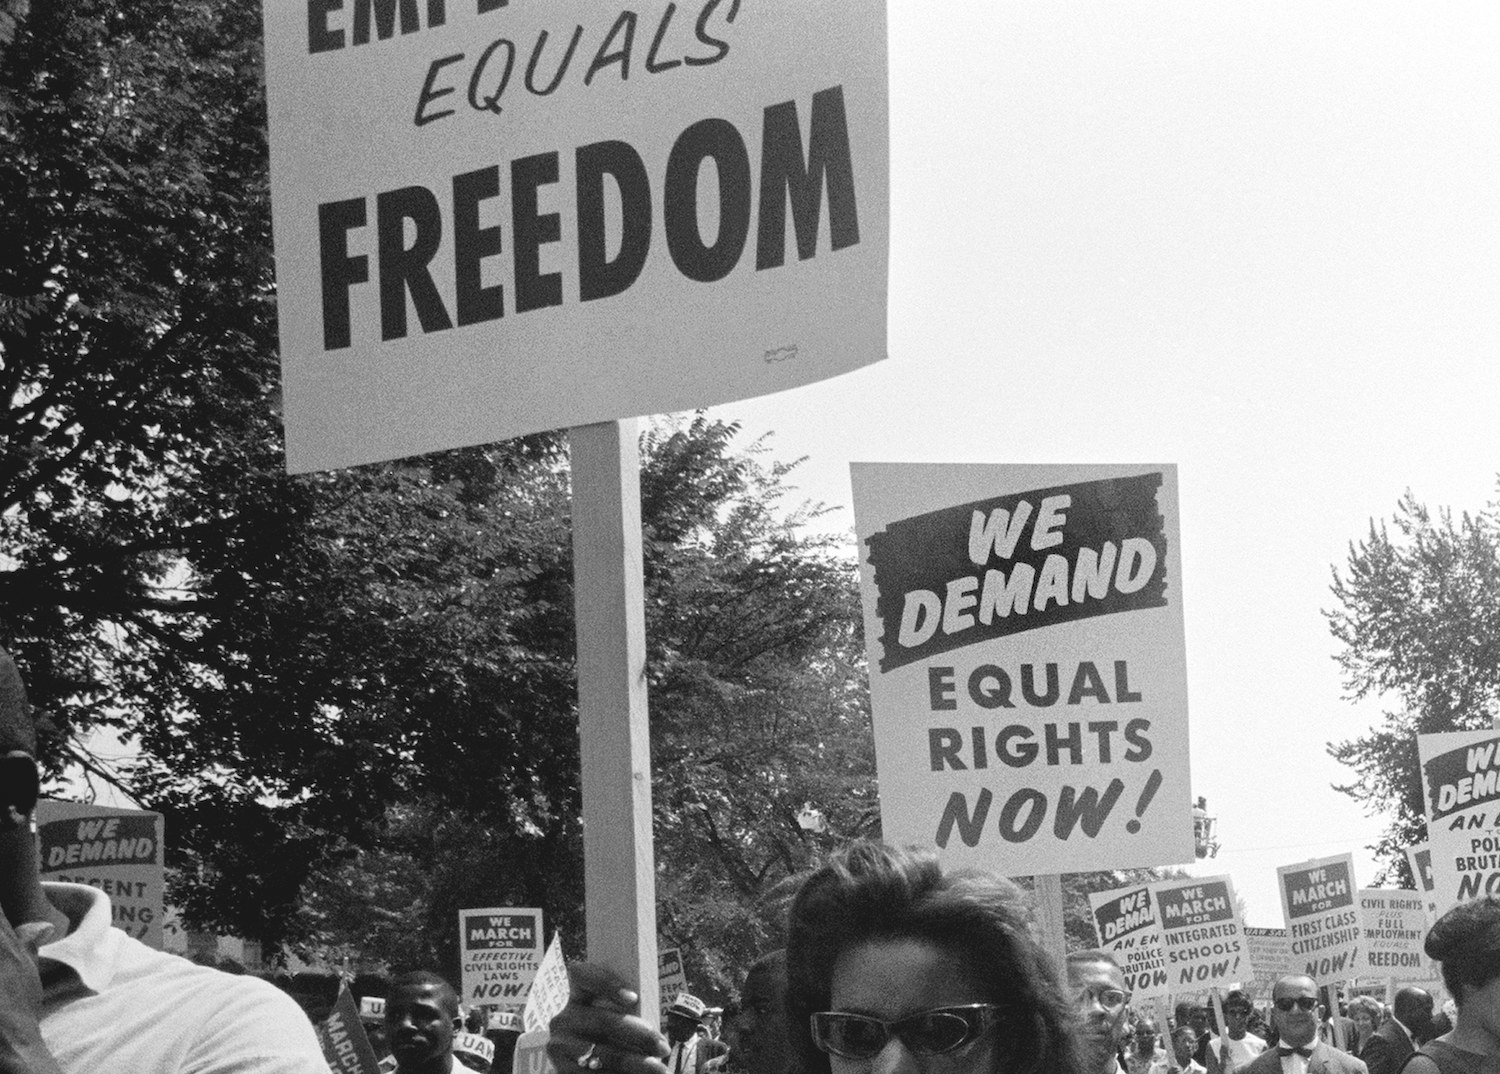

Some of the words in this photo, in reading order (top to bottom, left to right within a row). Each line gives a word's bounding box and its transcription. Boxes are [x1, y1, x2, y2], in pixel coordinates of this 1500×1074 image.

[413, 0, 741, 127] EQUALS
[318, 84, 860, 352] FREEDOM
[968, 494, 1072, 565] WE
[898, 537, 1157, 648] DEMAND
[928, 660, 1143, 711] EQUAL
[928, 718, 1153, 772] RIGHTS
[935, 768, 1163, 850] NOW!
[77, 818, 121, 841] WE
[1449, 812, 1487, 831] AN
[48, 837, 154, 867] DEMAND
[59, 875, 147, 898] CENT
[1308, 869, 1327, 884] WE
[1119, 891, 1147, 915] WE
[1182, 887, 1204, 900] WE
[1292, 879, 1346, 906] MARCH
[1165, 896, 1226, 918] MARCH
[1312, 900, 1332, 912] FOR
[1361, 899, 1386, 910] CIVIL
[1390, 900, 1422, 910] RIGHTS
[489, 917, 511, 927] WE
[1104, 905, 1155, 940] DEMA
[1186, 914, 1211, 924] FOR
[1291, 919, 1322, 938] FIRST
[1325, 911, 1357, 930] CLASS
[1378, 919, 1404, 929] FULL
[470, 928, 531, 941] MARCH
[489, 940, 514, 948] FOR
[1113, 937, 1135, 951] AN
[1140, 934, 1160, 946] EN
[1165, 923, 1237, 946] INTEGRATED
[1291, 927, 1360, 955] CITIZENSHIP
[472, 952, 534, 962] EFFECTIVE
[1127, 948, 1163, 964] POLICE
[1169, 940, 1241, 963] SCHOOLS
[1305, 946, 1358, 977] NOW!
[1368, 952, 1421, 967] REEDOM
[464, 962, 496, 972] CIVIL
[496, 962, 539, 971] RIGHTS
[484, 973, 519, 981] LAWS
[1120, 958, 1165, 976] BRUTALIT
[1179, 956, 1240, 985] NOW!
[473, 982, 534, 998] NOW!
[1124, 970, 1167, 992] NOW
